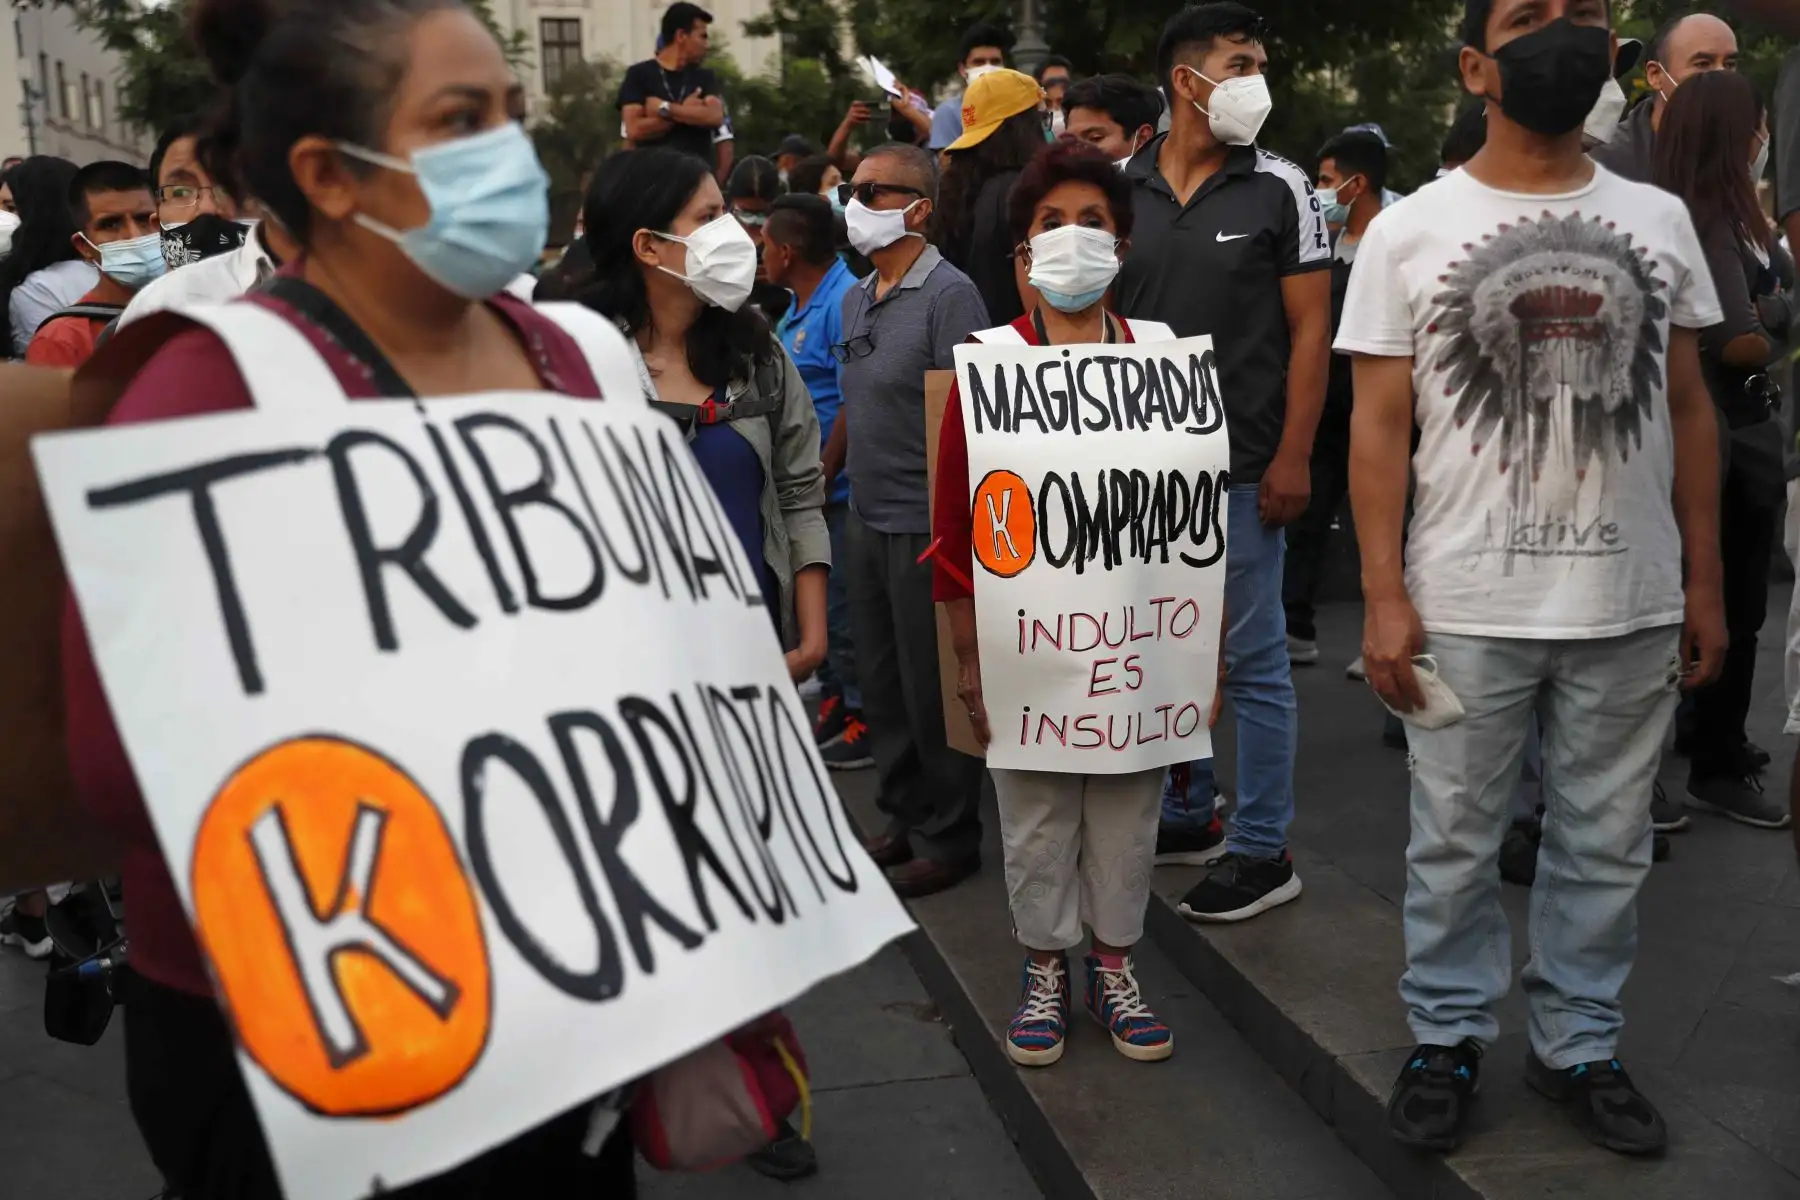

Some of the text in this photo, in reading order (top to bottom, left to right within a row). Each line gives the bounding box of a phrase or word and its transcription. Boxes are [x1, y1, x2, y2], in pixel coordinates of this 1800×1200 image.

[1304, 181, 1320, 212] DO
[87, 411, 763, 694] TRIBUNAL
[1088, 654, 1143, 697] ES
